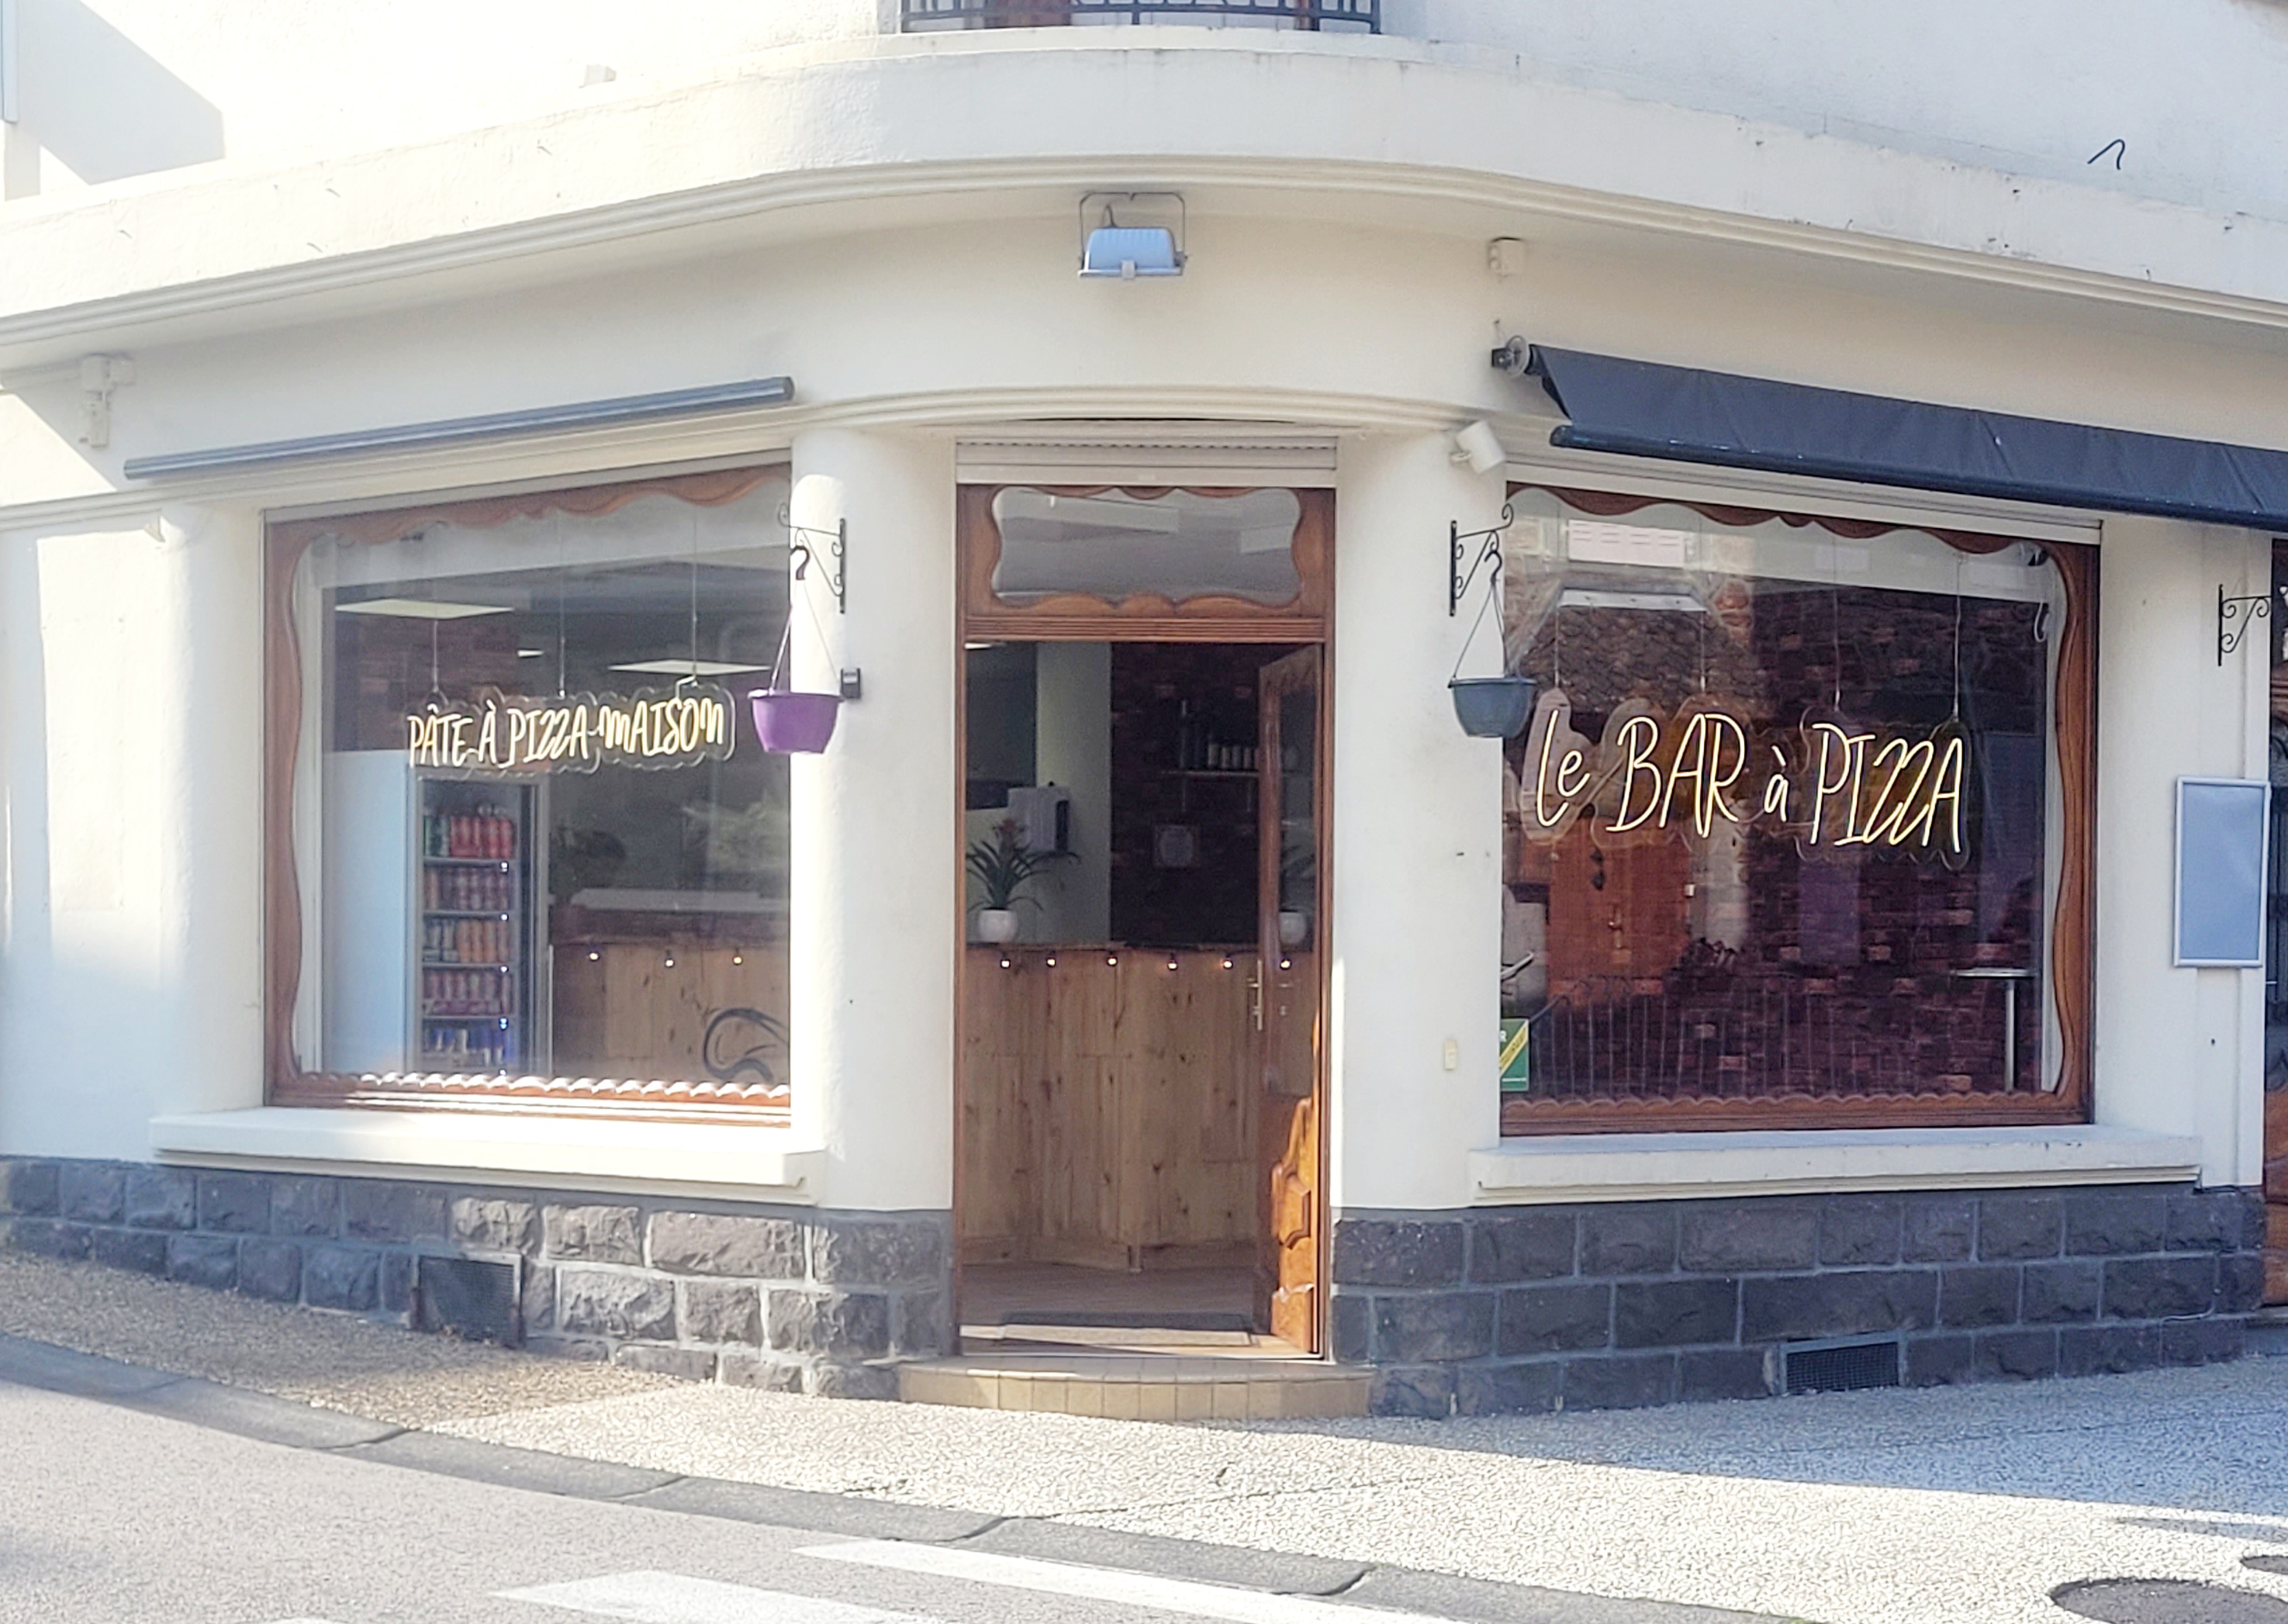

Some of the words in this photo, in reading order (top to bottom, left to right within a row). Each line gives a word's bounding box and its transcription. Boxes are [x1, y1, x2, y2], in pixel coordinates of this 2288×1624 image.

[406, 703, 474, 769] PÂTE
[478, 698, 498, 764] À
[501, 704, 589, 769] PIZZA
[1605, 713, 1746, 839] BAR
[1763, 745, 1788, 822] à
[1809, 722, 1963, 853] PIZZA
